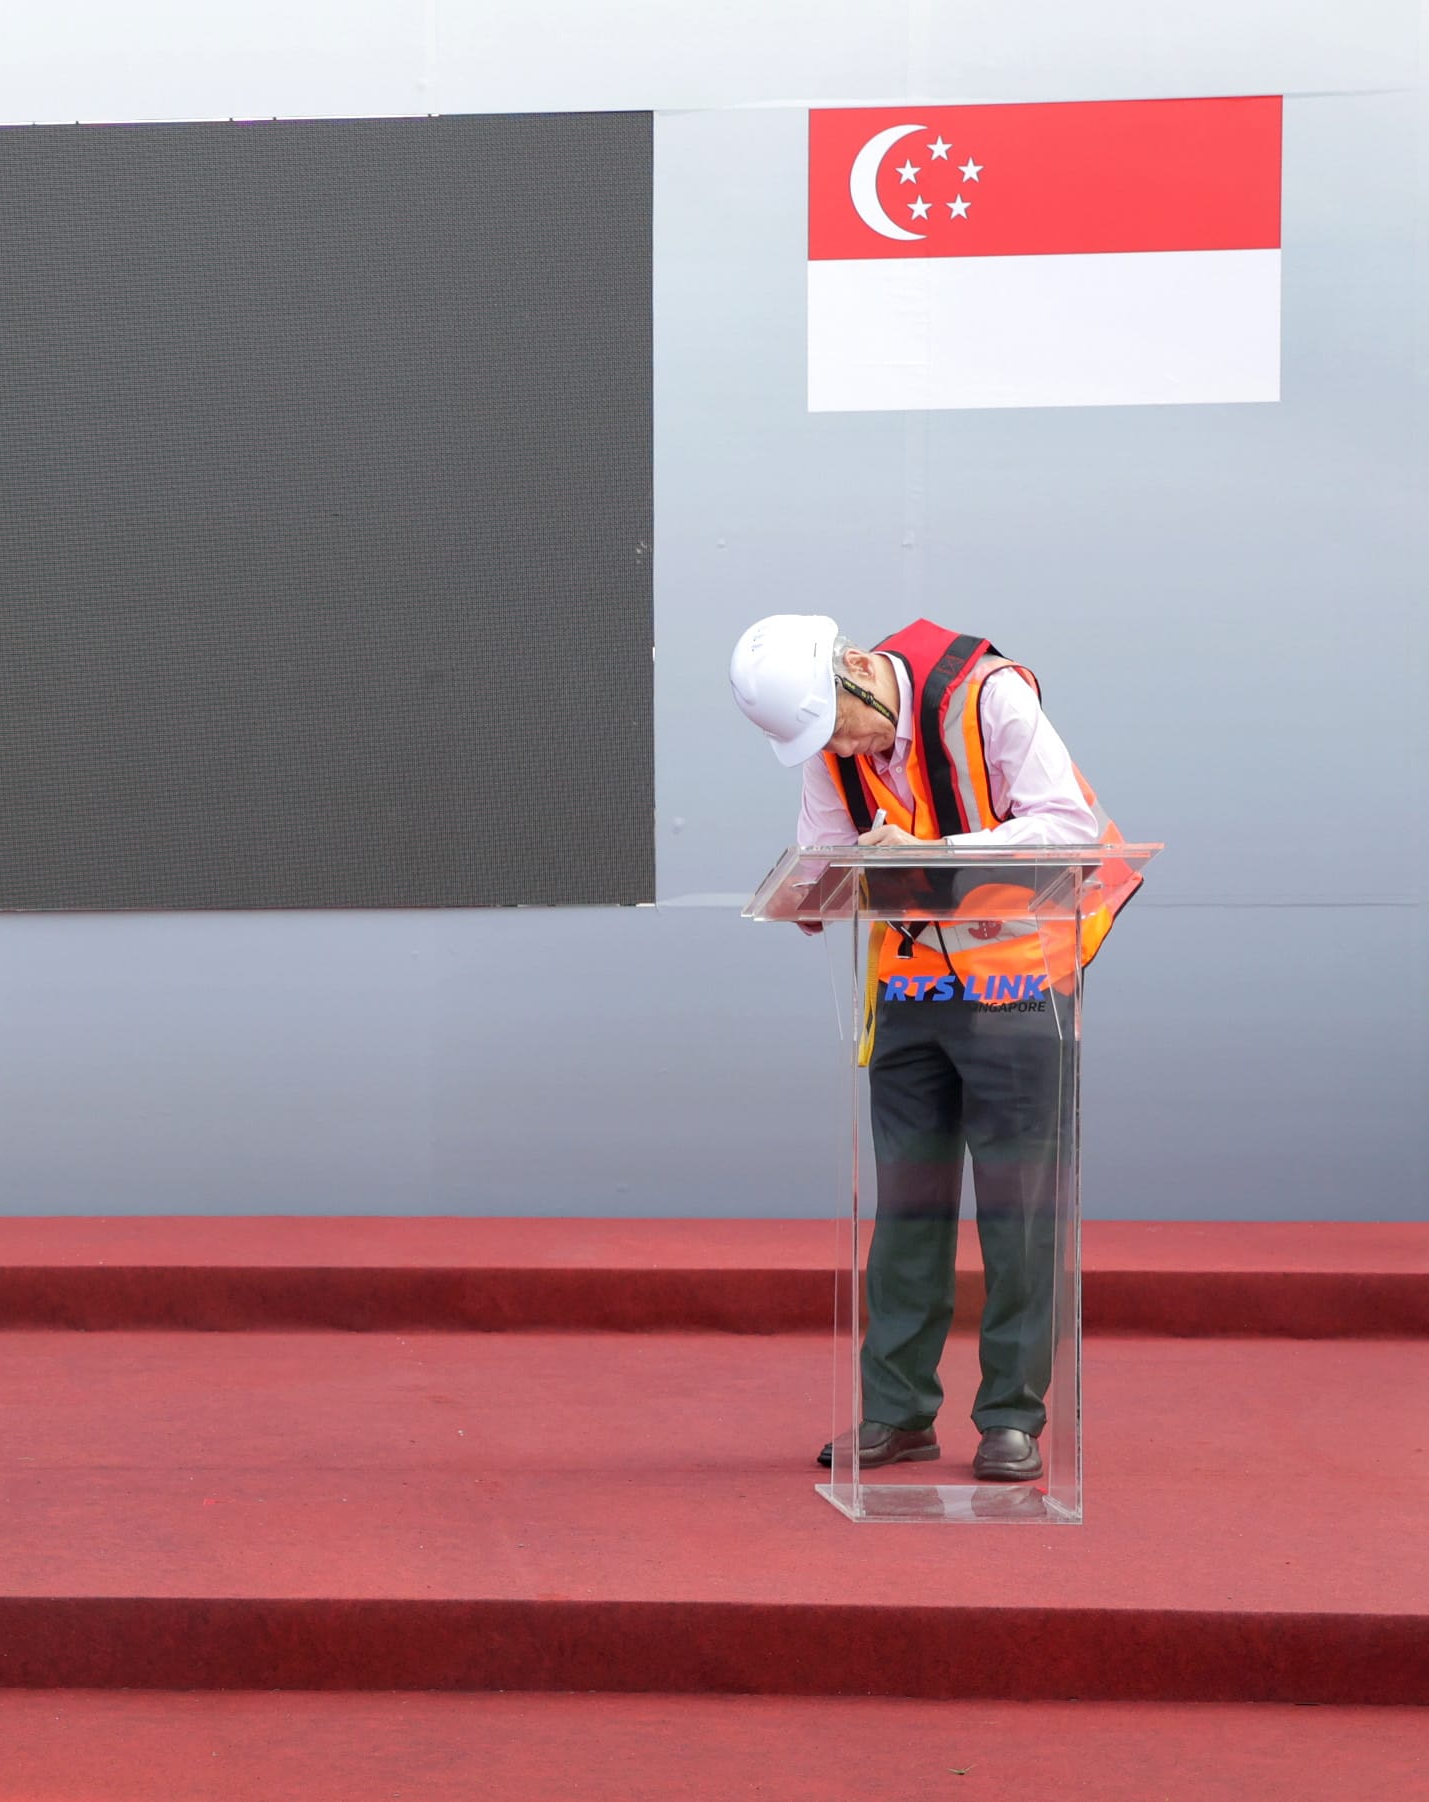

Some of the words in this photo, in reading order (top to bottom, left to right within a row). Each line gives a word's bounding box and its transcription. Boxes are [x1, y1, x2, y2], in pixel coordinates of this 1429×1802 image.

[884, 975, 956, 1001] RTS
[963, 975, 1048, 1001] LINK
[967, 1001, 1046, 1013] NGAPORE
